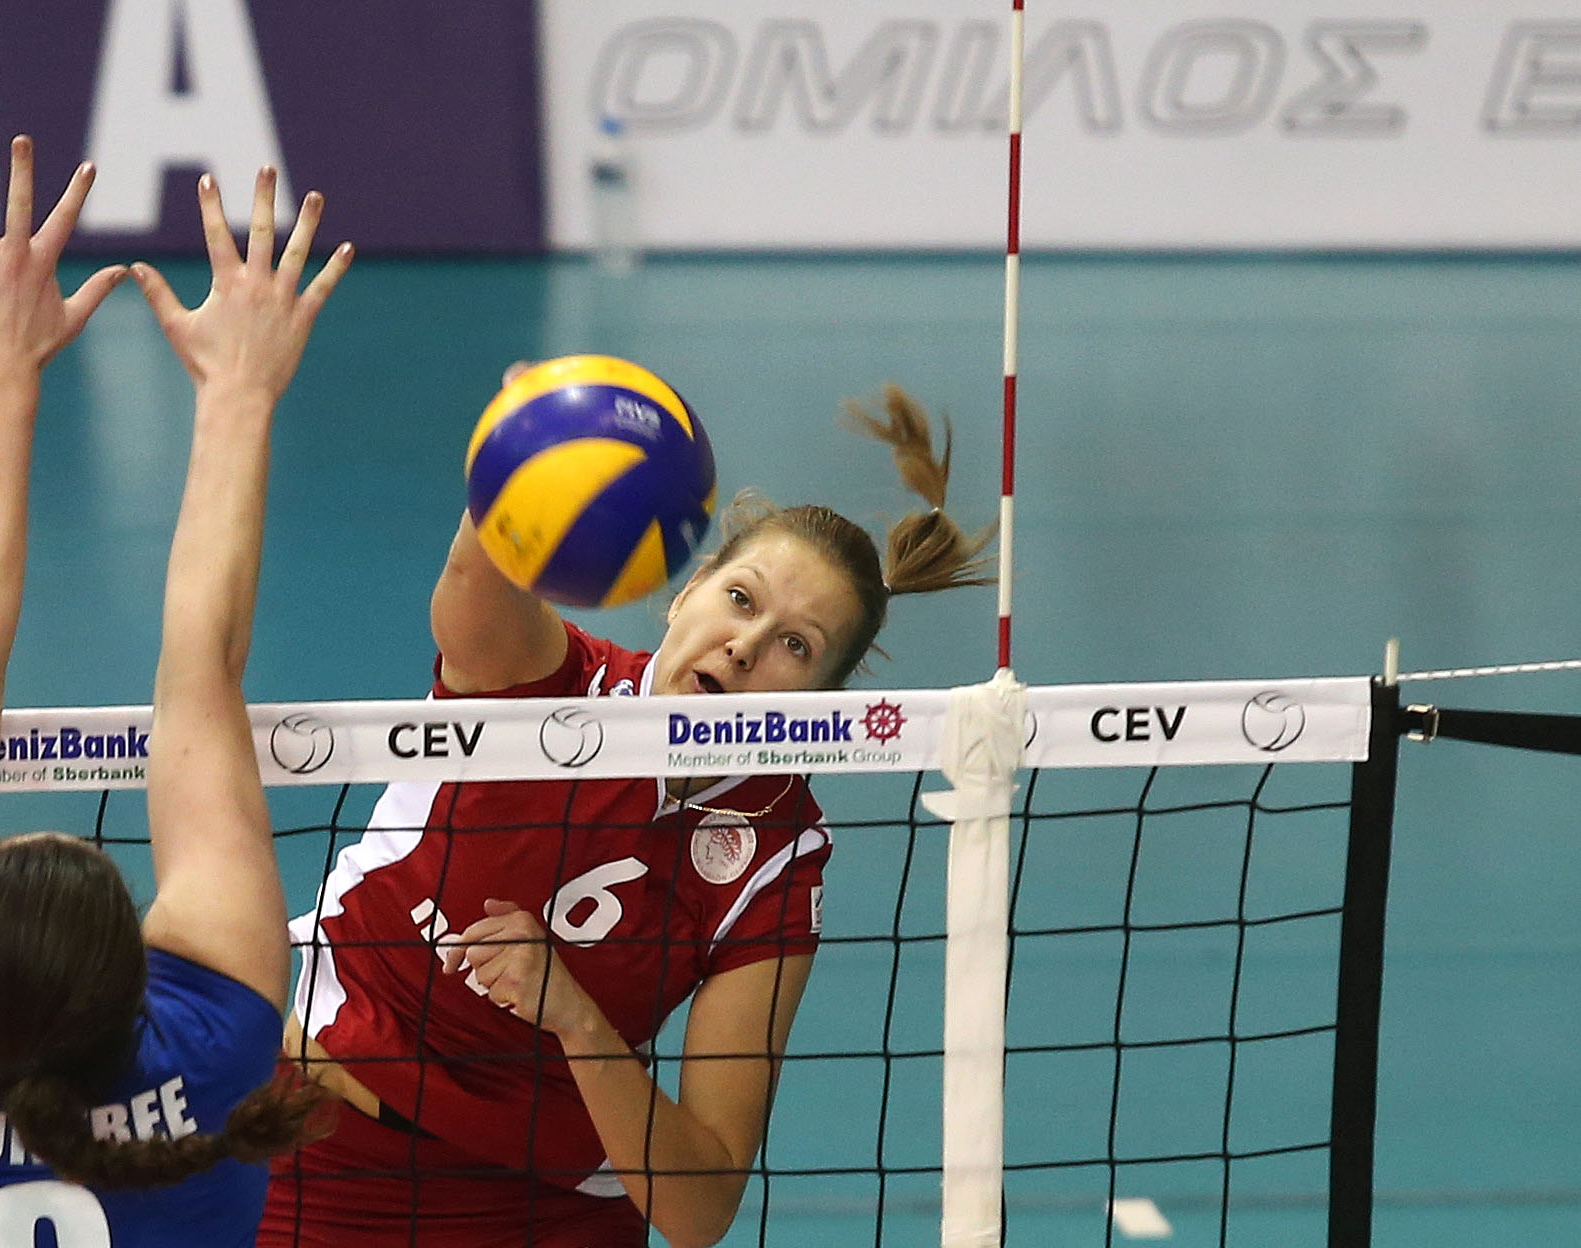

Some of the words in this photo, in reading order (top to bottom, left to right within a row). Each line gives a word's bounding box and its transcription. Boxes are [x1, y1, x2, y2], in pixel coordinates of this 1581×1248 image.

[387, 721, 485, 758] CEV
[669, 711, 853, 745] DenizBank
[1090, 706, 1187, 742] CEV
[32, 767, 47, 782] of
[52, 765, 146, 781] Sberbank
[668, 752, 732, 768] Member
[737, 751, 752, 766] of
[757, 749, 849, 765] Sberbank
[852, 748, 902, 766] Group
[543, 856, 649, 947] 6
